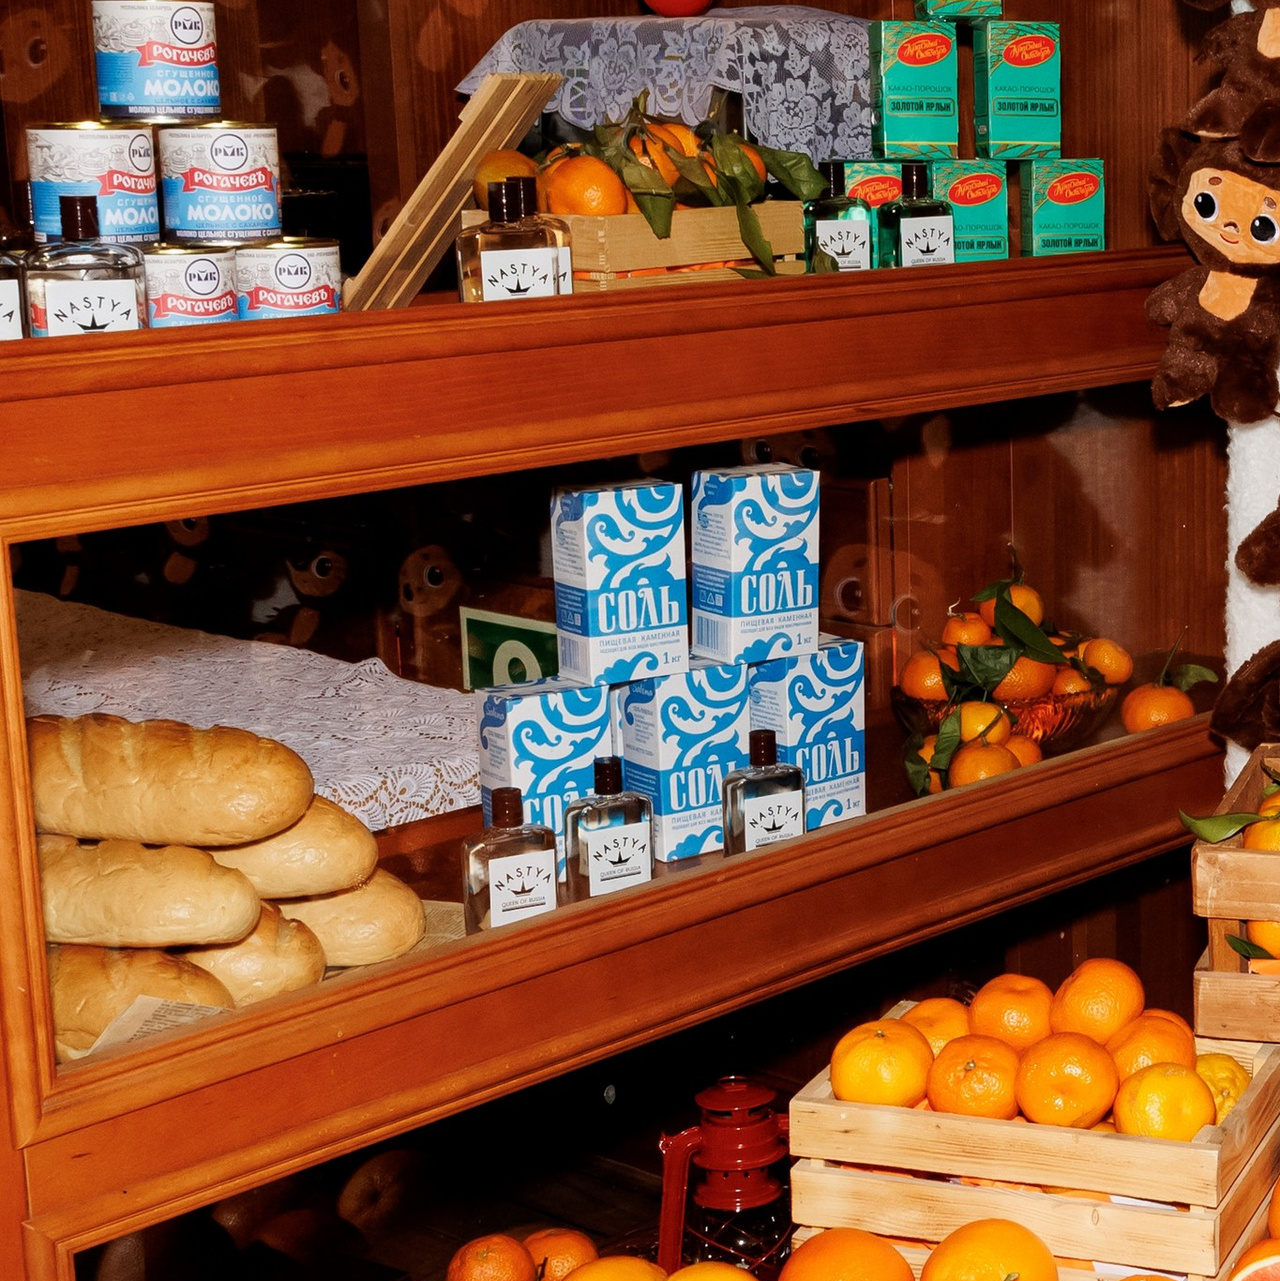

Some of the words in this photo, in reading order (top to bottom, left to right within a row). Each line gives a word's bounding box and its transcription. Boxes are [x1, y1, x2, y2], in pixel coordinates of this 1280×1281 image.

[157, 70, 214, 78] СГУЩЕННОЕ
[144, 80, 220, 97] МОЛОКО
[888, 85, 952, 93] КАКАО-ПОРОШОК
[995, 85, 1056, 94] КАКАО-ПОРОШОК
[129, 106, 156, 114] МОЛОКО
[891, 101, 923, 112] ЗОЛОТОЙ
[925, 102, 951, 112] ЯРЛЫК
[997, 101, 1028, 112] ЗОЛОТОЙ
[1030, 102, 1055, 112] ЯРЛЫК
[198, 195, 263, 203] СГУЩЕННОЕ
[105, 208, 159, 225] МОЛО
[187, 203, 274, 221] МОЛОКО
[820, 230, 866, 250] NASTYA
[905, 228, 950, 249] NASTYA
[976, 240, 1002, 249] ЯРЛЫК
[1041, 237, 1072, 248] ЗОЛОТОЙ
[1074, 237, 1099, 247] ЯРЛЫК
[488, 263, 548, 287] NASTYA
[54, 296, 131, 322] NASTYA
[741, 569, 812, 614] СОЛЬ
[598, 586, 679, 633] СОЛЬ
[741, 618, 774, 628] ПИЩЕВАЯ
[778, 612, 812, 623] КАМЕННАЯ
[599, 637, 637, 647] ПИЩЕВАЯ
[641, 630, 680, 642] КАМЕННАЯ
[797, 633, 802, 645] 1
[663, 652, 669, 664] 1
[796, 737, 859, 783] СОЛЬ
[670, 761, 736, 811] СОЛ
[830, 777, 859, 790] КАМЕННАЯ
[846, 798, 851, 810] 1
[671, 811, 706, 824] ПИЩЕВАЯ
[749, 805, 799, 828] NASTYA
[593, 837, 646, 861] NASTYA
[495, 866, 551, 891] NASTYA
